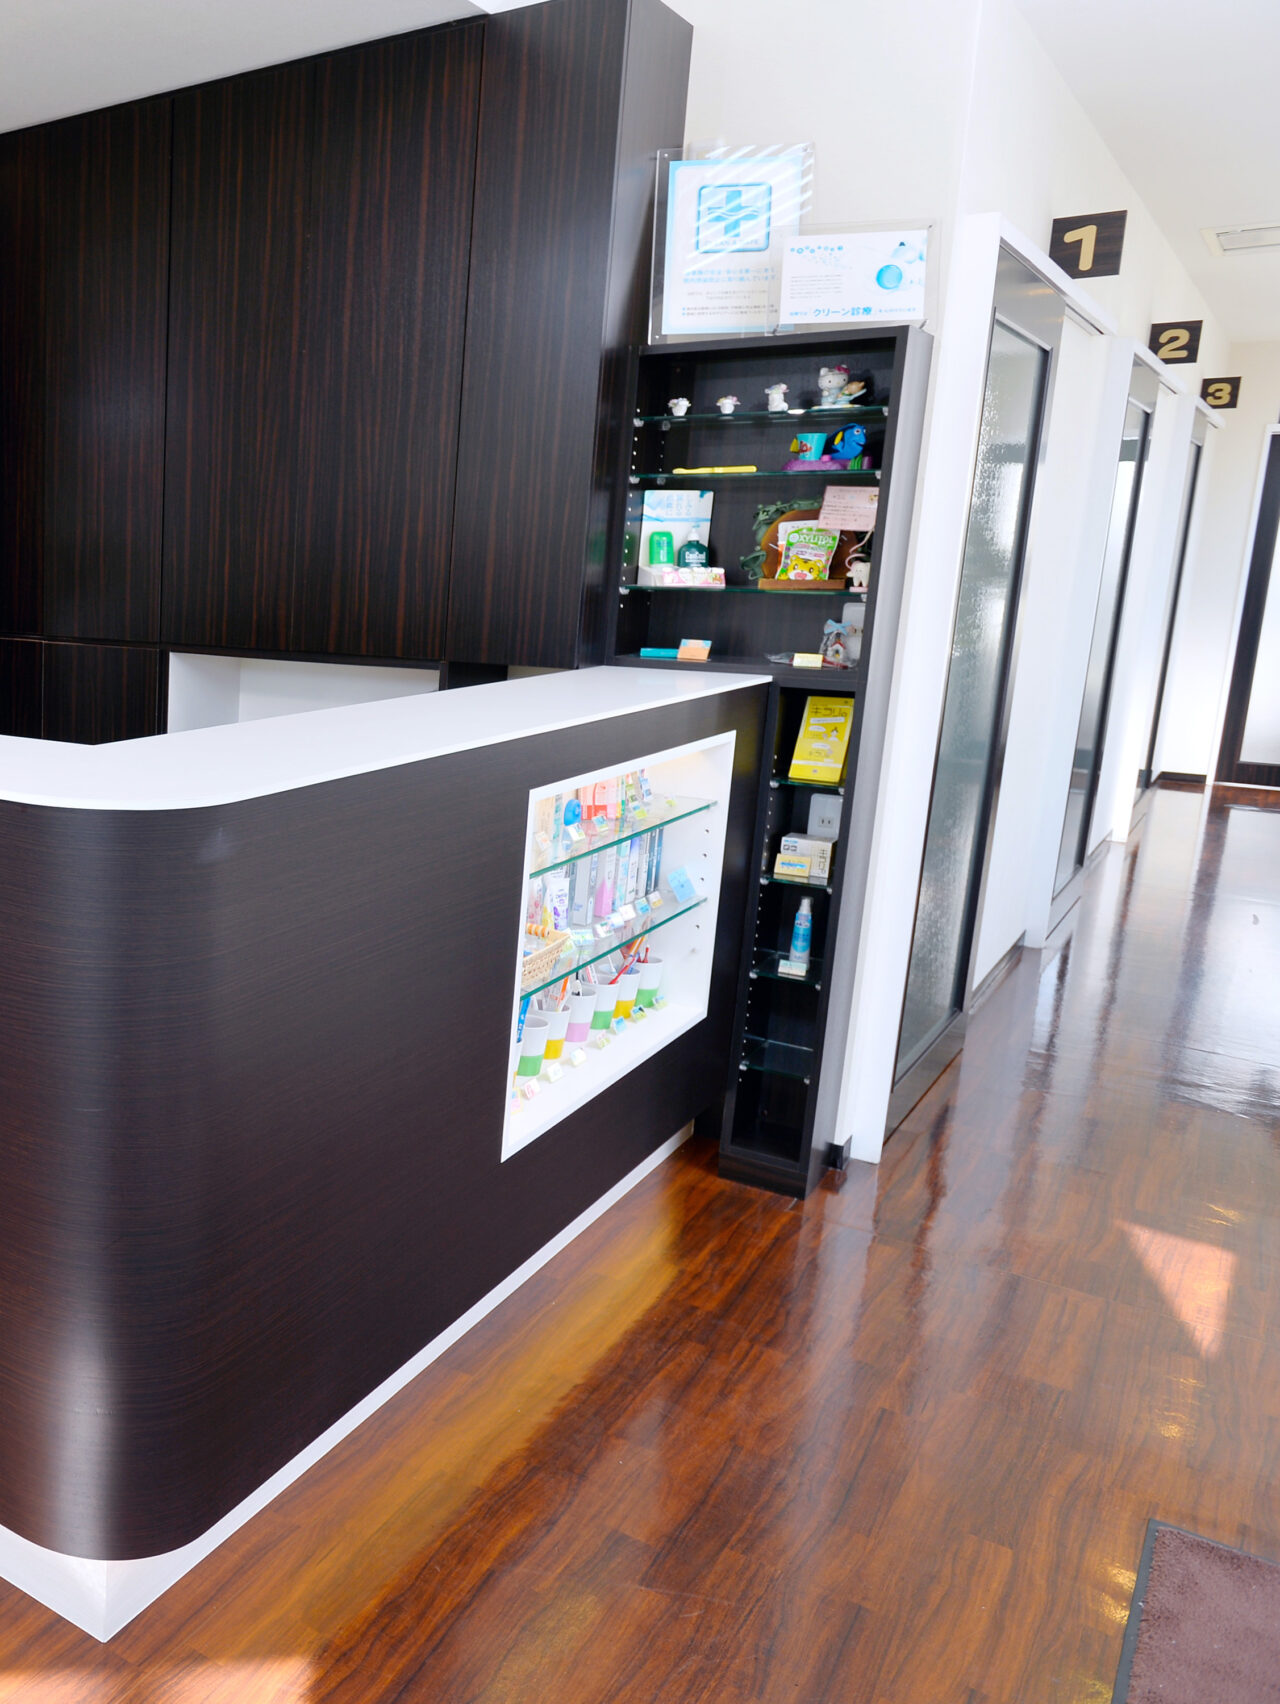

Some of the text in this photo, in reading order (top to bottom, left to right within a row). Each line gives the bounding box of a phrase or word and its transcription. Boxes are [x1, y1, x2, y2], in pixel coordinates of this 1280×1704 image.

[1063, 224, 1097, 271] 1
[1157, 328, 1190, 359] 2
[1206, 382, 1232, 406] 3
